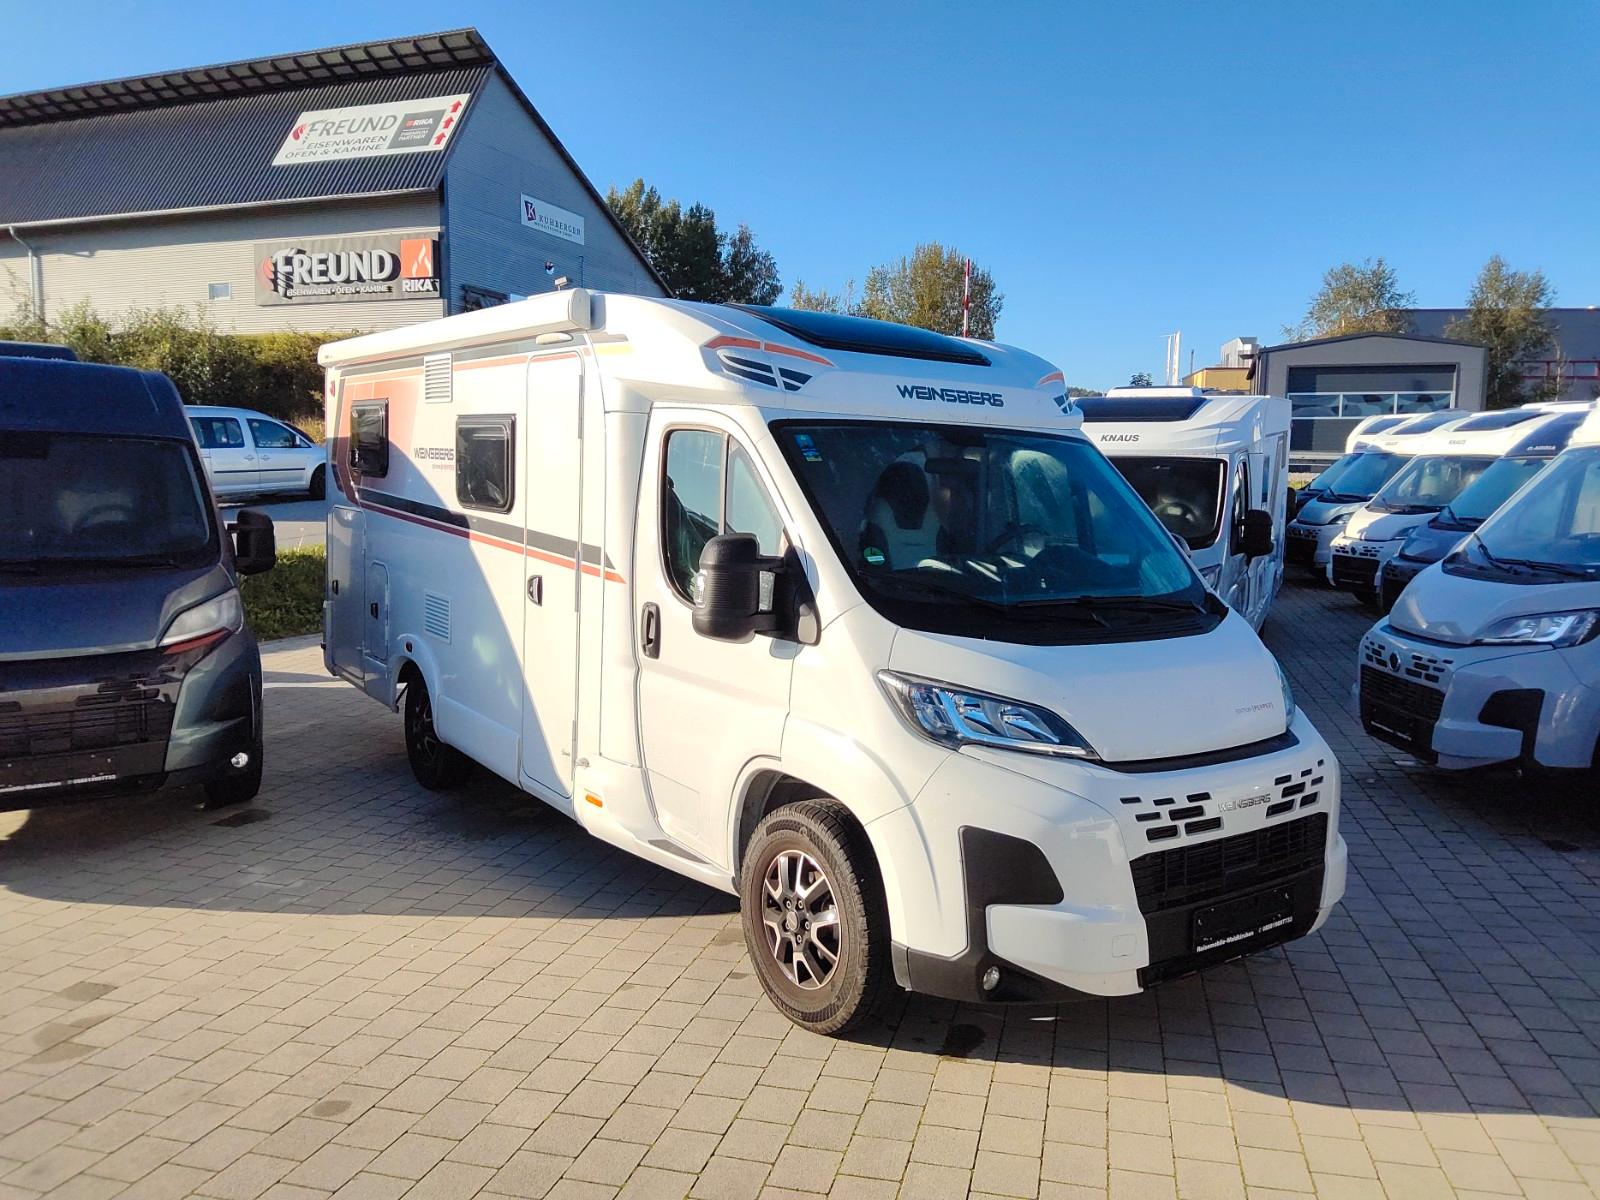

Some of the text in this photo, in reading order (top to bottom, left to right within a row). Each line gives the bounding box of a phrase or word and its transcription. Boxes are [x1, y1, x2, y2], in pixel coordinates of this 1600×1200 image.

[306, 114, 397, 139] FREUND
[306, 135, 388, 149] EISENWAREN
[332, 144, 383, 154] KAMINE
[272, 248, 393, 296] FREUND
[286, 286, 331, 297] EISENWAREN
[360, 284, 389, 293] KAMINE
[402, 279, 433, 292] RIKA
[896, 384, 1004, 408] WEINSBERG
[1100, 434, 1140, 442] KNAUS
[1218, 793, 1271, 812] WEINSBERG
